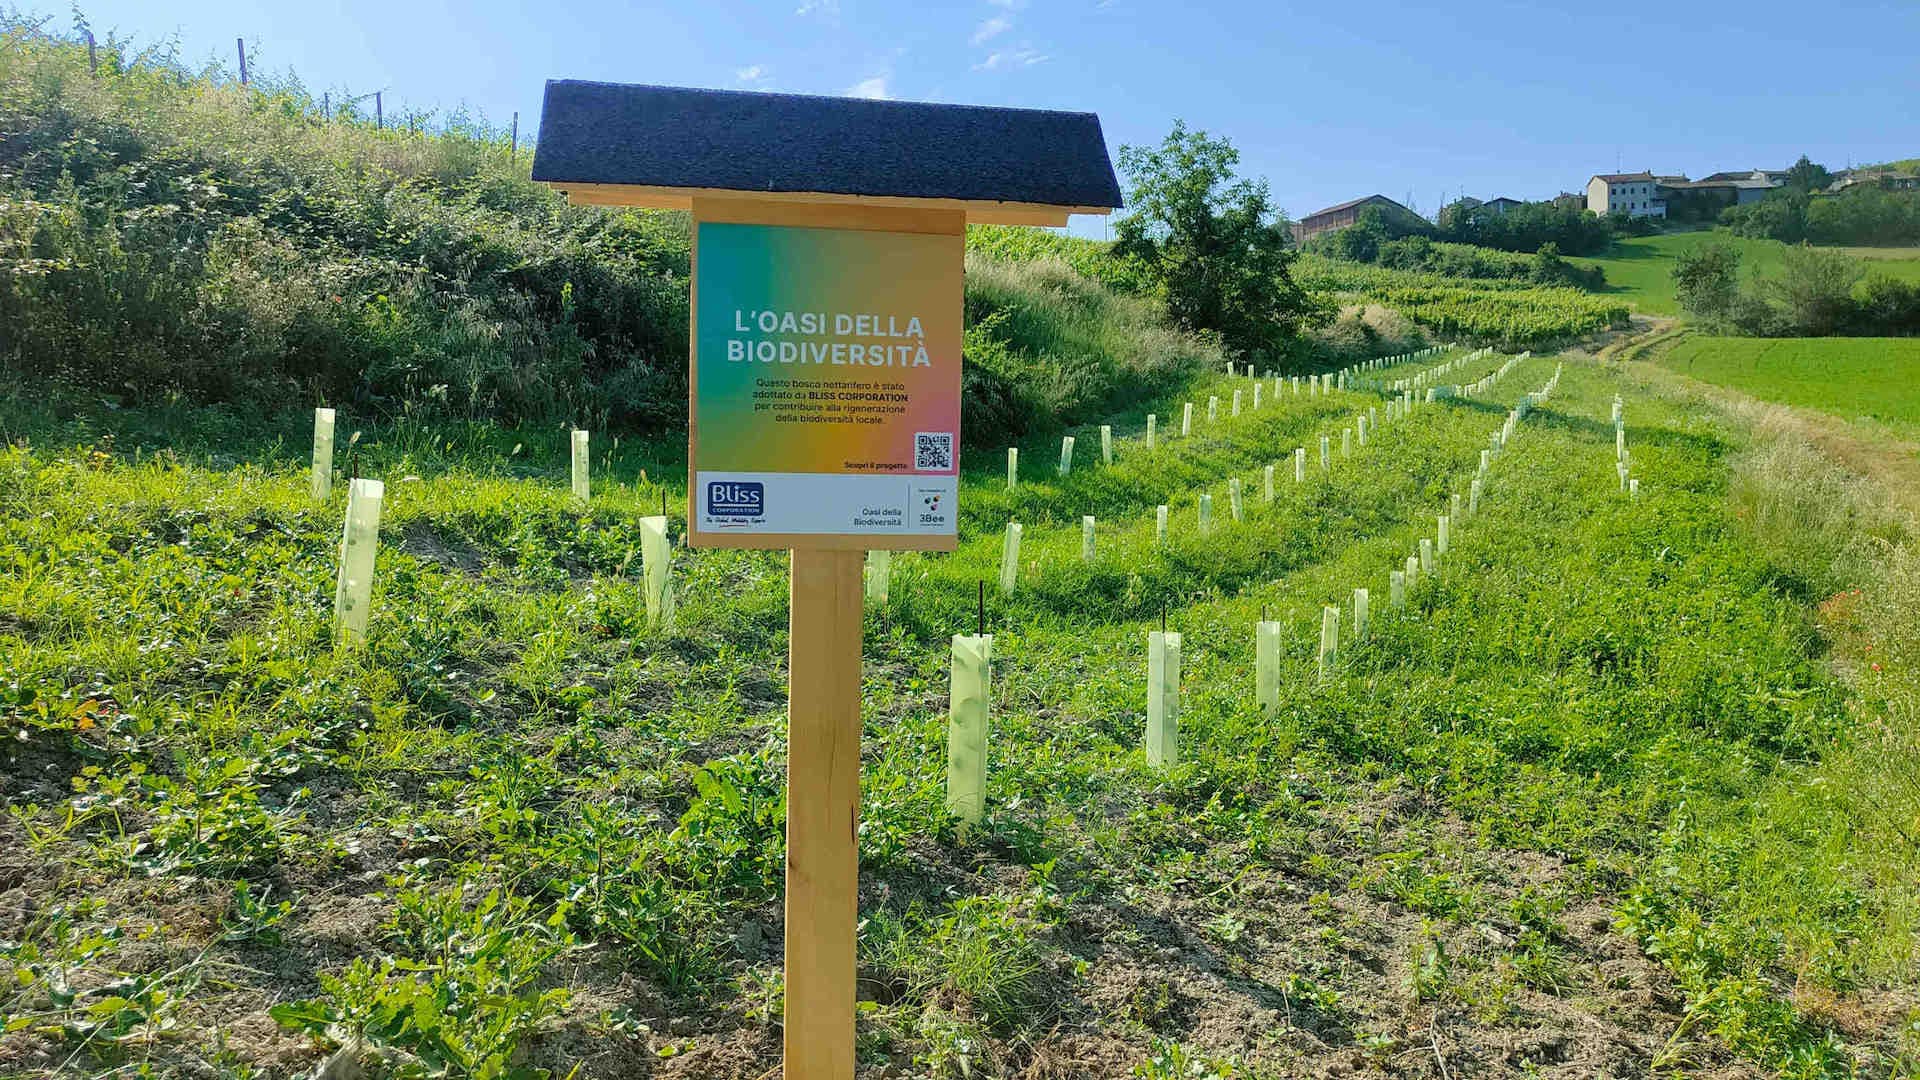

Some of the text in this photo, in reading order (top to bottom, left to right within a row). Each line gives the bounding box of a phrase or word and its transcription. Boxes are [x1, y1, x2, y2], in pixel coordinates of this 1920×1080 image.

[735, 310, 925, 338] L'OASI DELLA
[727, 339, 931, 367] BIODIVERSITÀ
[756, 378, 790, 388] Questo
[792, 380, 821, 388] bosco
[873, 382, 880, 390] è
[882, 383, 905, 391] stato
[752, 391, 909, 402] adottato da BLISS CORPORATION
[754, 402, 906, 414] per contribuire alla rigenerazione
[775, 415, 798, 423] della
[800, 415, 854, 423] biodiversità
[844, 461, 869, 469] Scopri
[712, 484, 760, 503] Bliss
[862, 508, 902, 516] Oasi della
[854, 518, 902, 526] Biodiversità
[919, 513, 945, 523] 3Bee
